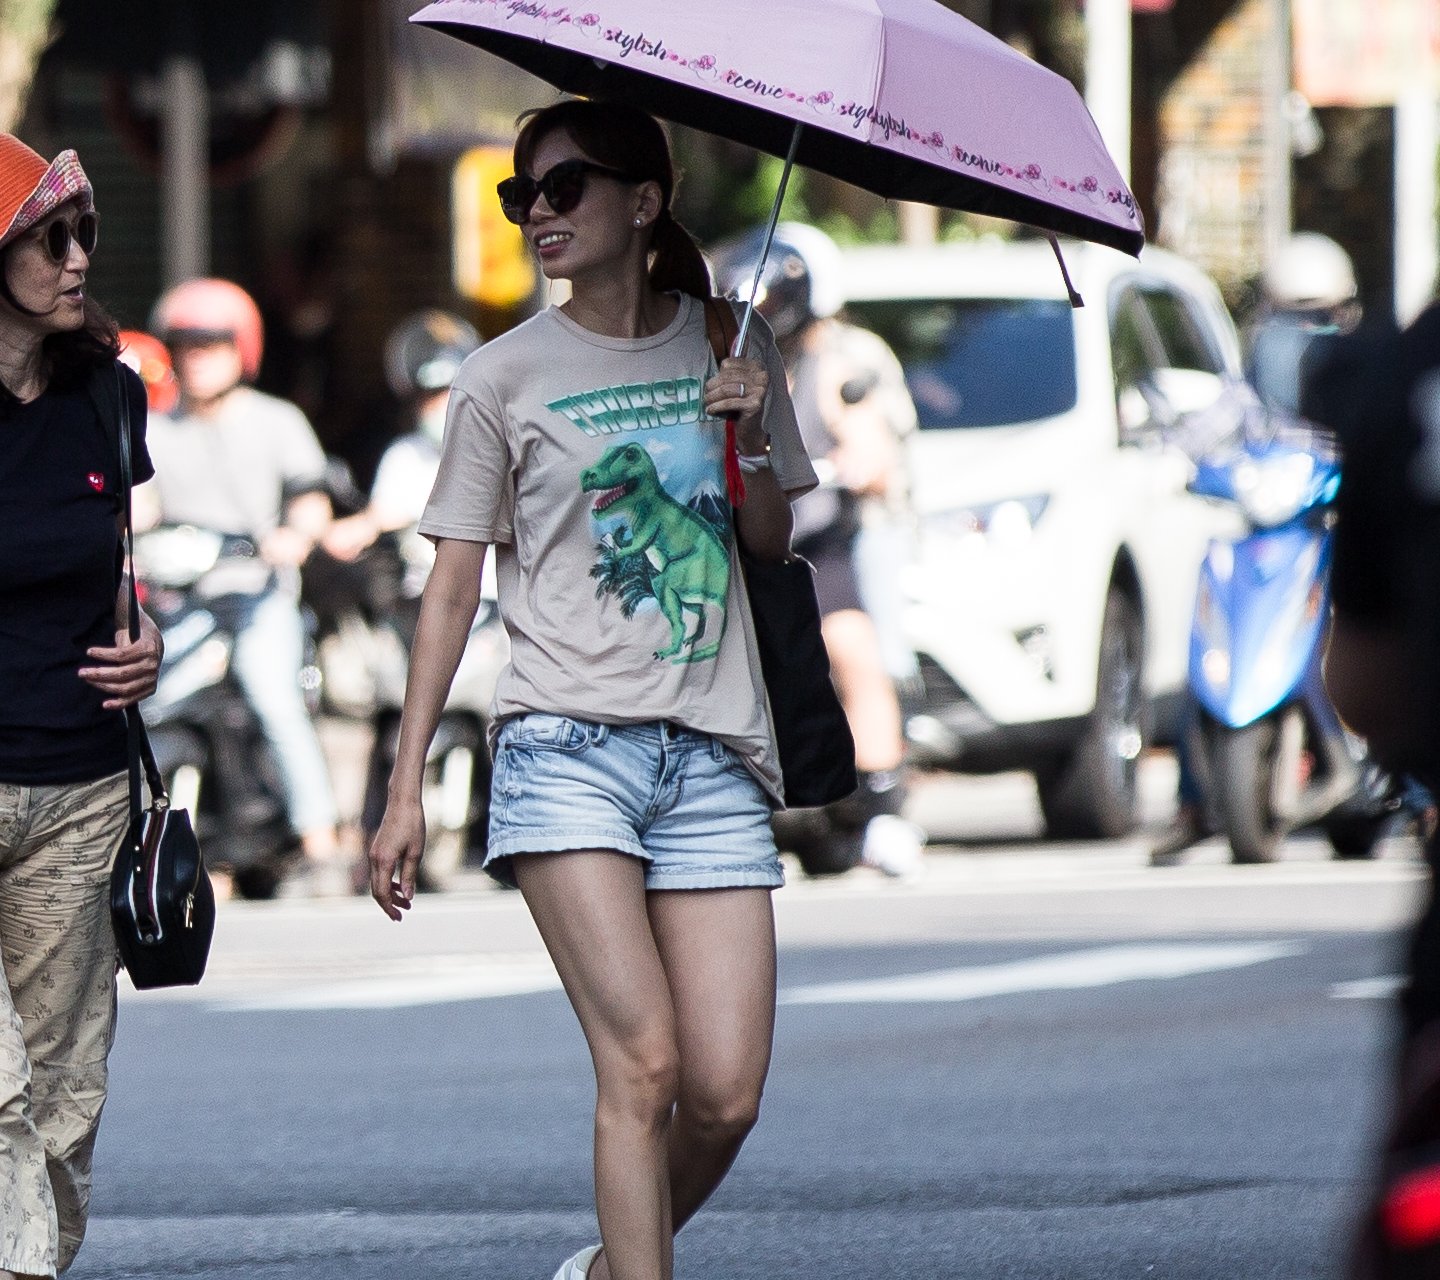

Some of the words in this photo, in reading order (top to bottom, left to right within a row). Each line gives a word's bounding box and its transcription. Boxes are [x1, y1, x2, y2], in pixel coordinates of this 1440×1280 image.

[606, 29, 668, 62] stylish
[726, 72, 785, 99] iconic
[955, 147, 1005, 177] iconic
[543, 375, 704, 439] THURSD
